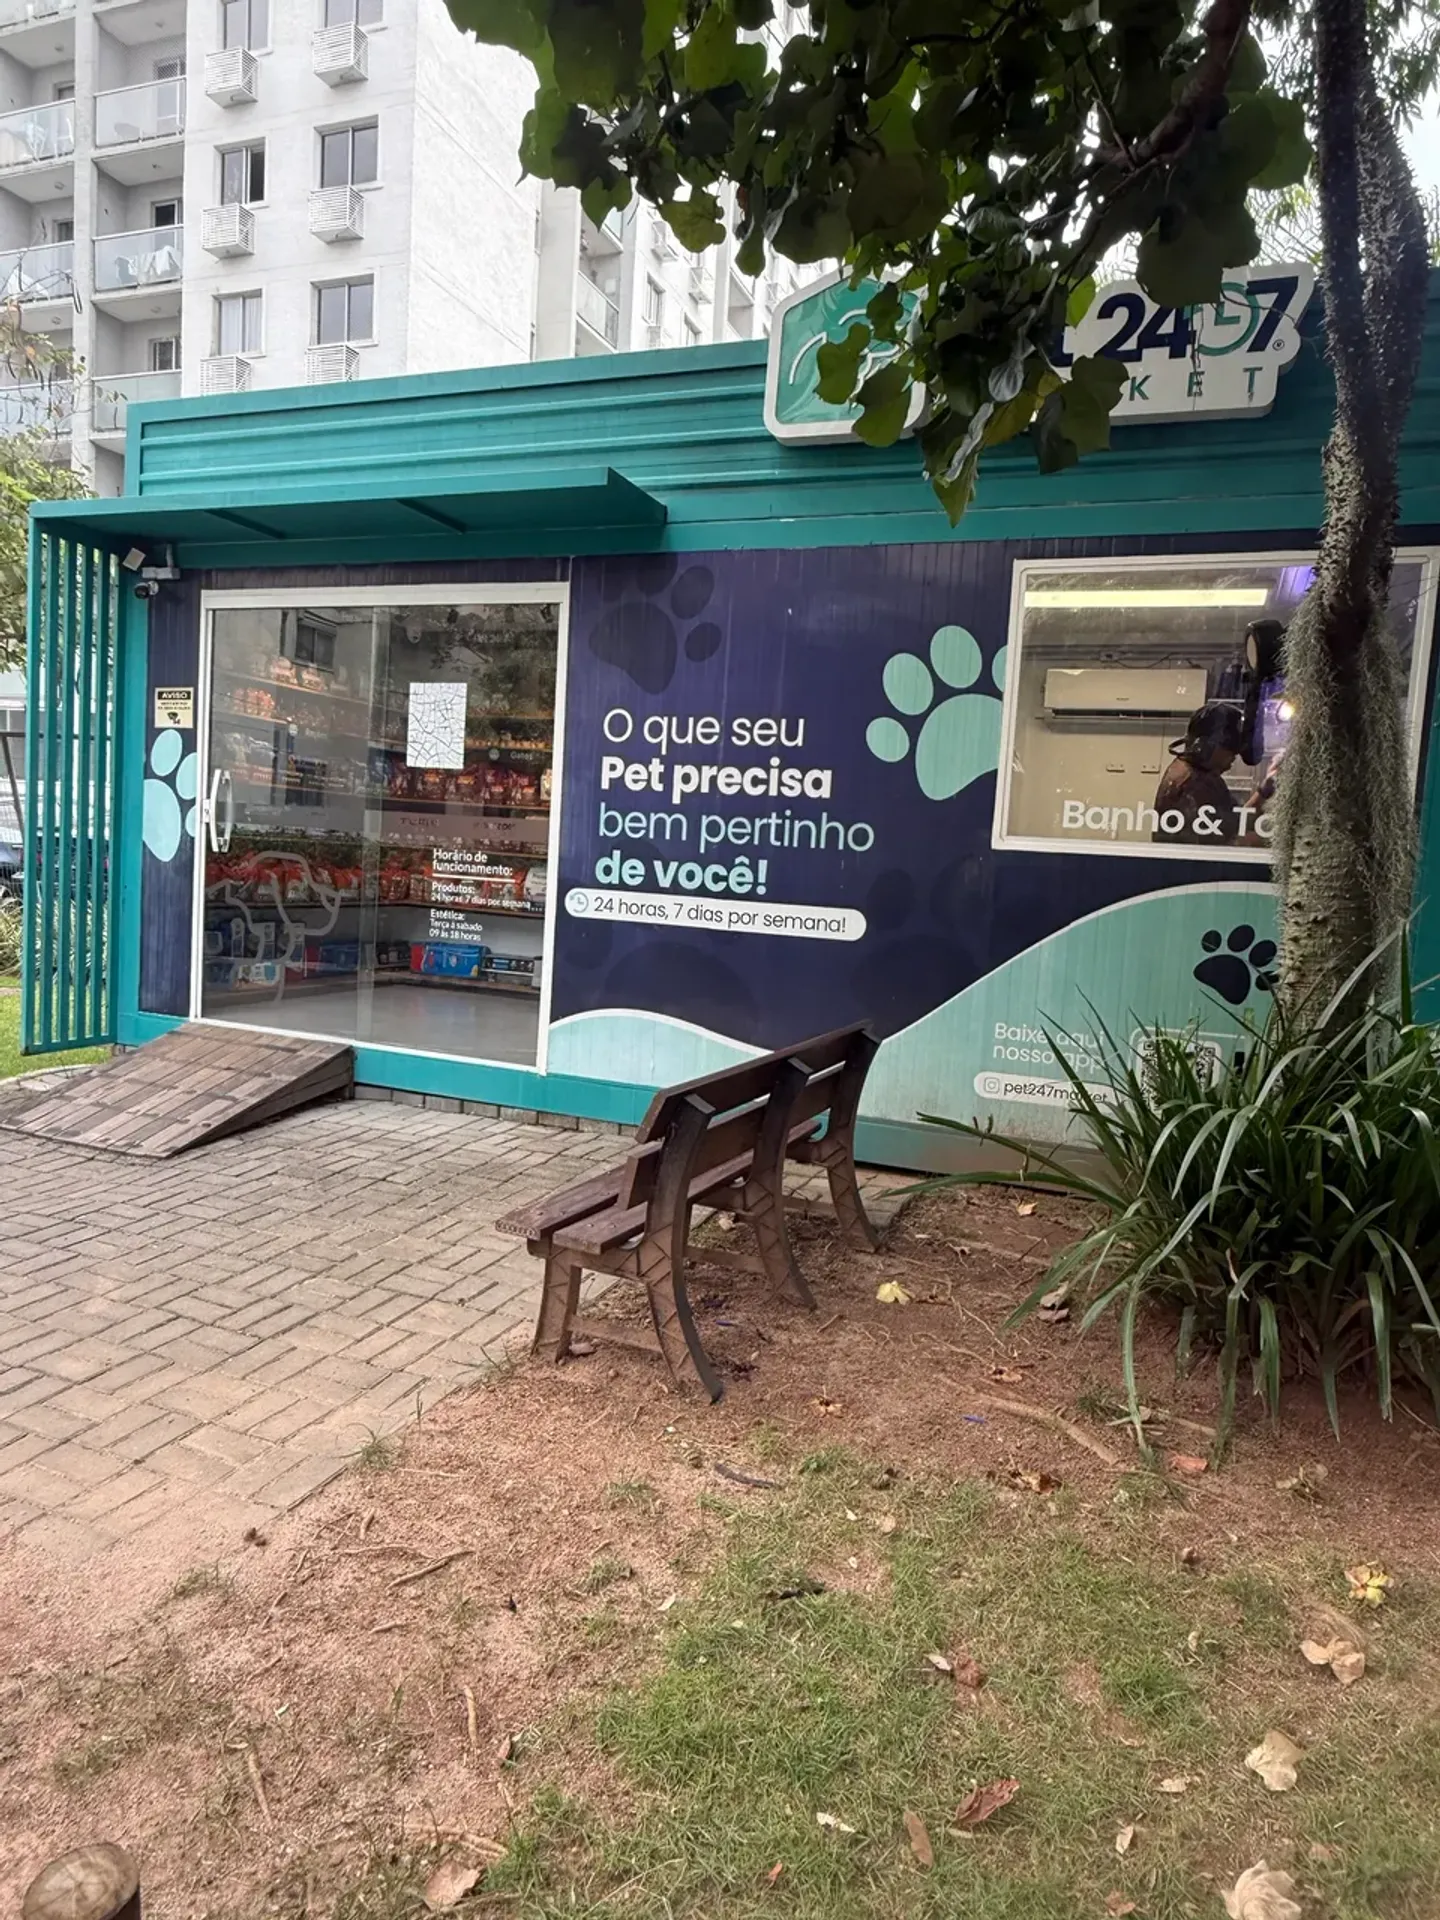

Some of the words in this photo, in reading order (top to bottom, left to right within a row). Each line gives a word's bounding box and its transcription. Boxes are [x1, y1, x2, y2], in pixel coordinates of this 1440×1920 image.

[161, 691, 188, 699] AVISO
[602, 708, 633, 743] O
[643, 716, 720, 755] que
[731, 717, 805, 747] seu
[601, 756, 664, 792] Pet
[672, 756, 832, 804] precisa
[599, 802, 687, 841] bem
[699, 809, 875, 853] pertinho
[1062, 799, 1185, 833] Banho
[1192, 805, 1223, 836] &
[1232, 807, 1275, 838] To
[432, 859, 513, 876] funcionamento:
[433, 848, 472, 861] Horário
[474, 851, 488, 863] de
[594, 850, 645, 886] de
[654, 855, 768, 895] você!
[431, 882, 476, 894] Produtos:
[430, 909, 466, 920] Estética:
[594, 897, 614, 914] 24
[618, 898, 669, 918] horas,
[673, 903, 684, 919] 7
[687, 904, 723, 923] dias
[728, 909, 759, 928] por
[763, 914, 847, 933] semana!
[429, 928, 440, 937] 09
[460, 931, 481, 941] horas
[994, 1023, 1048, 1044] Baixe
[1056, 1031, 1104, 1053] aqui
[992, 1045, 1054, 1064] nosso
